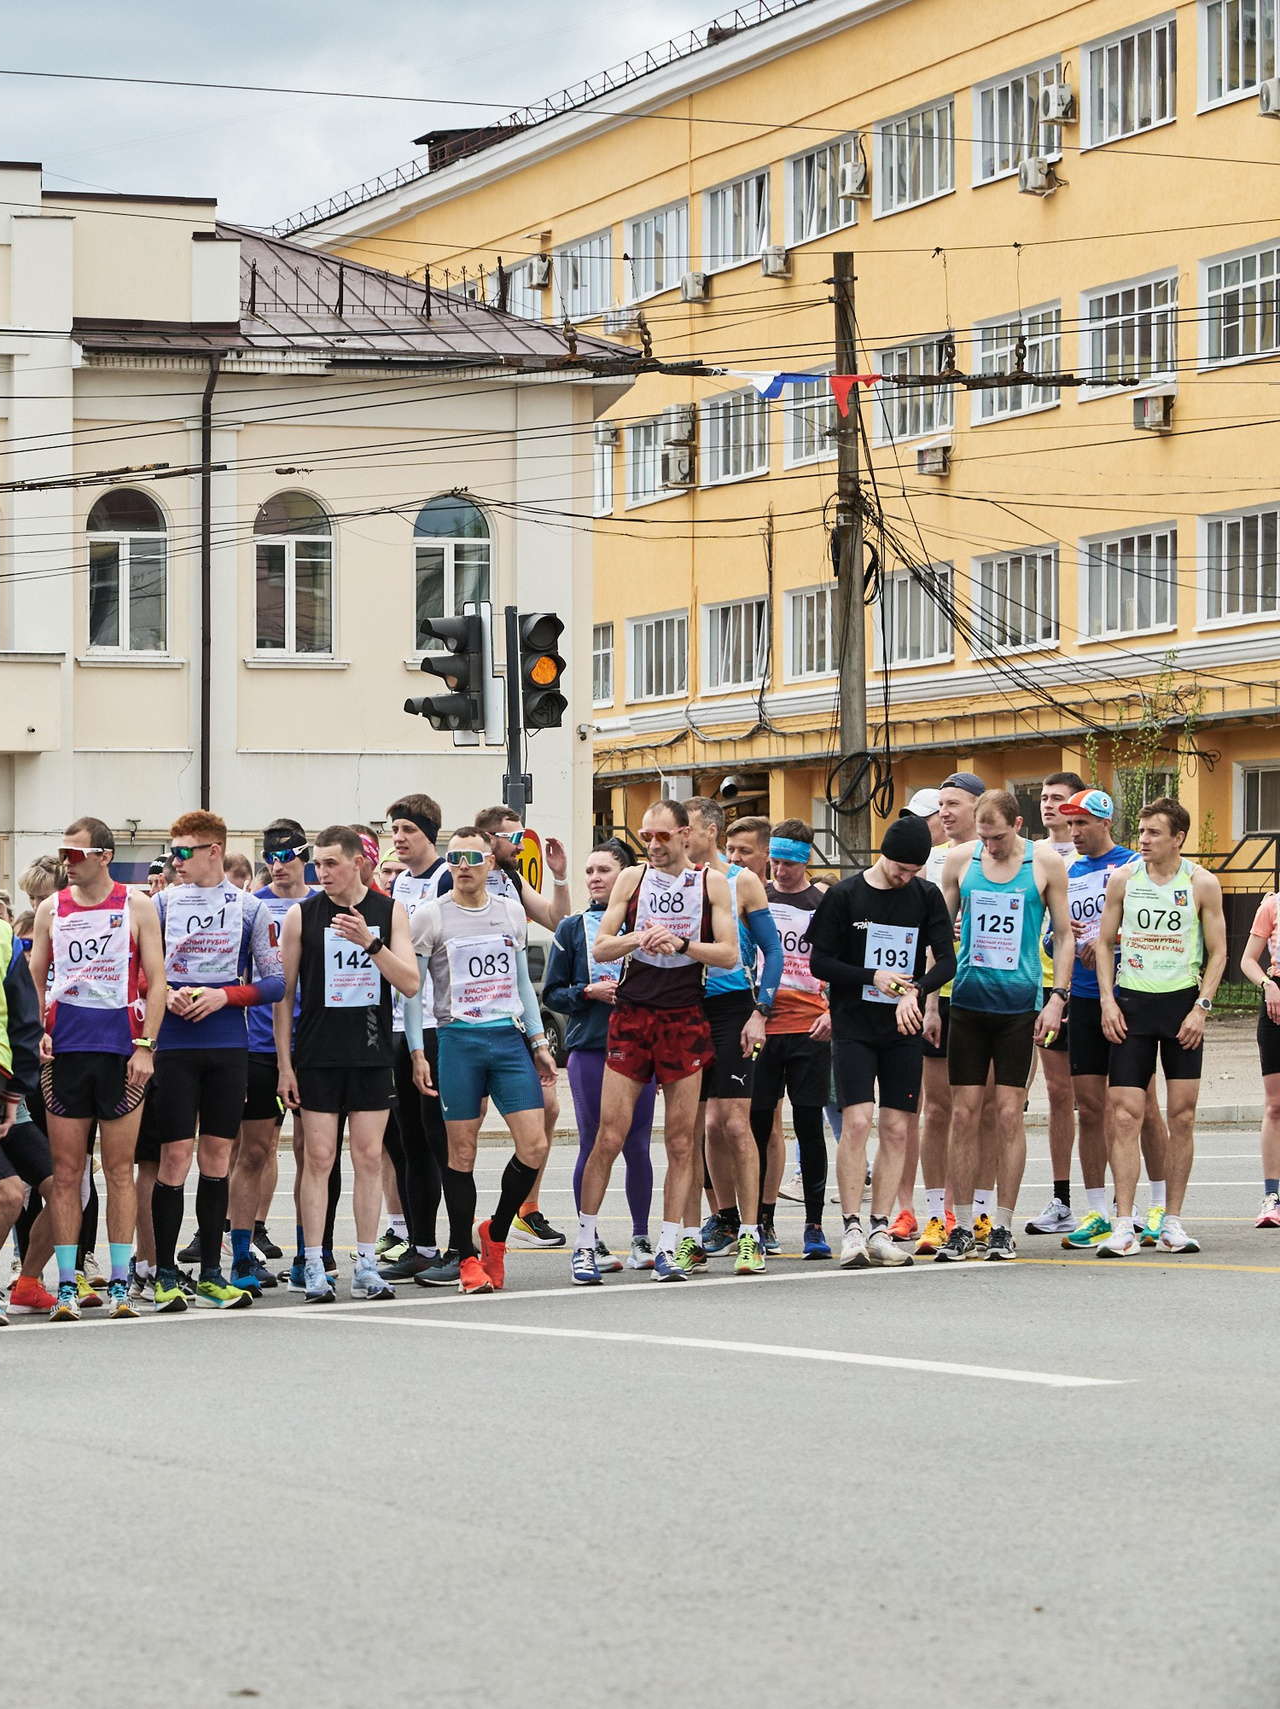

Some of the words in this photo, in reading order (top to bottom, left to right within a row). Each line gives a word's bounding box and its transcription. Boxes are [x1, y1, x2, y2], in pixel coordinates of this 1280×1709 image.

[977, 913, 1015, 934] 125
[1137, 908, 1182, 931] 078
[68, 934, 113, 963] 037
[777, 929, 811, 954] 66
[333, 950, 372, 969] 142
[468, 952, 510, 978] 083
[873, 947, 909, 969] 193
[464, 984, 496, 995] КРАСНЫЙ
